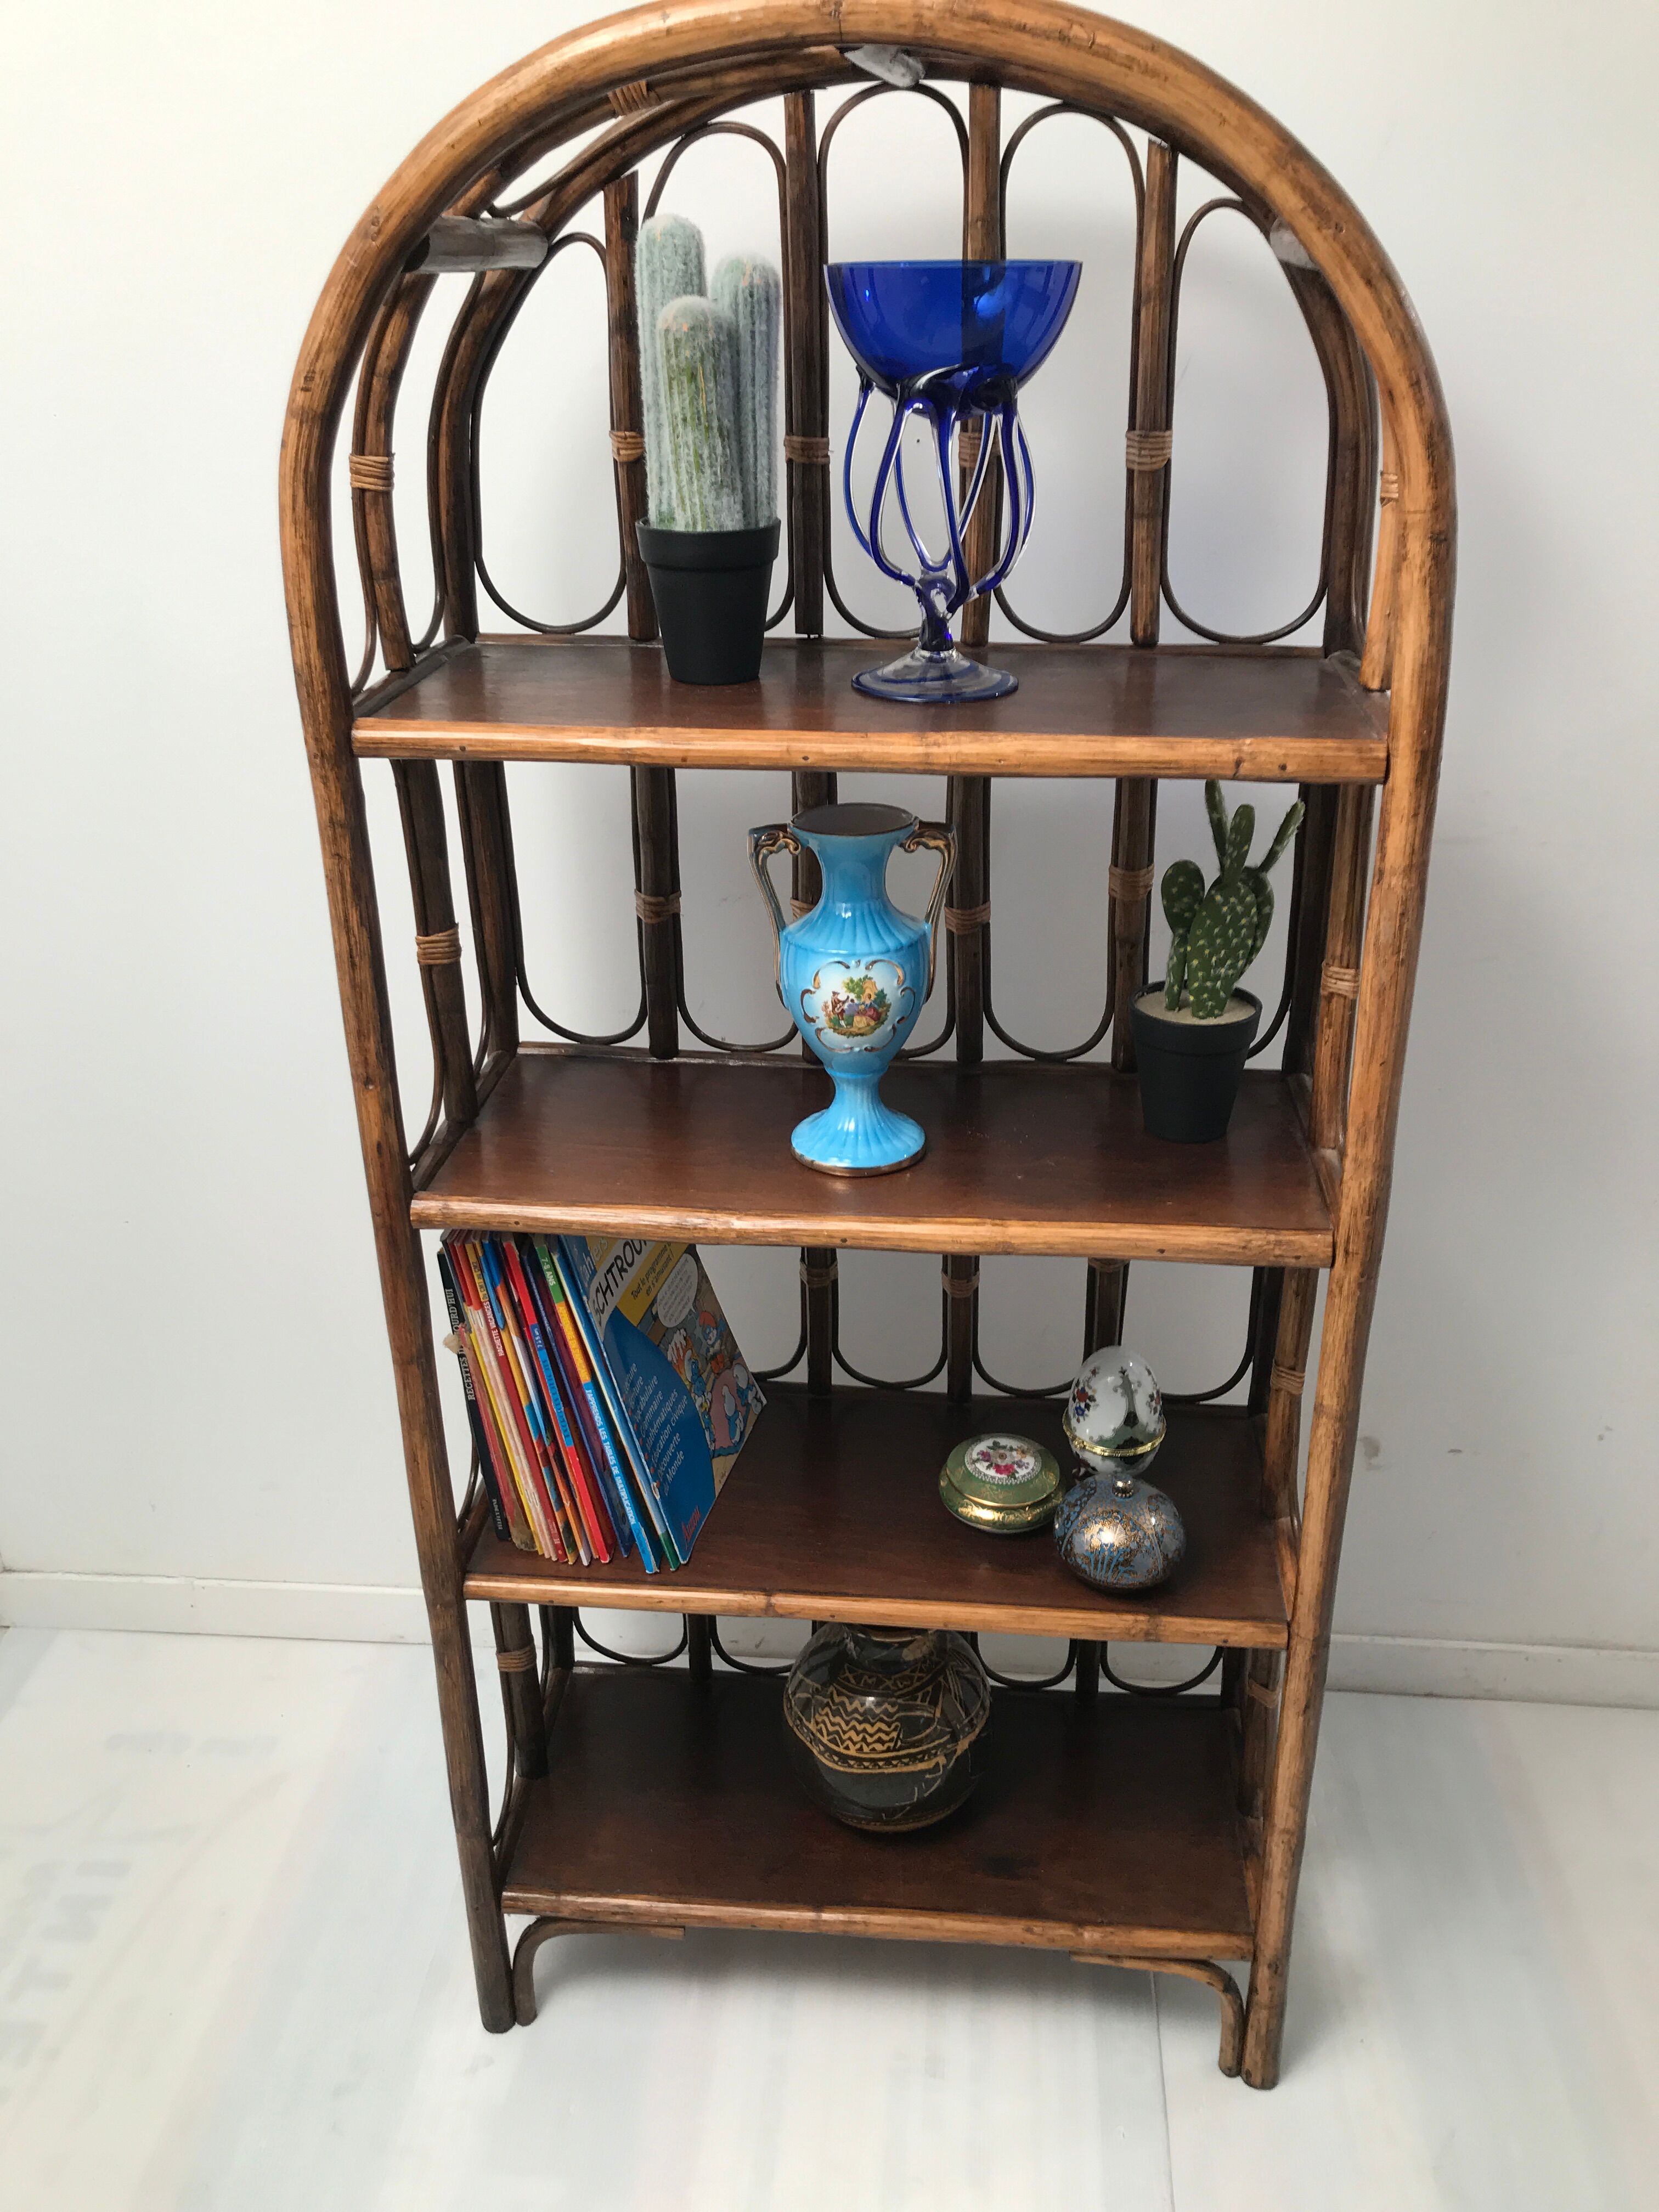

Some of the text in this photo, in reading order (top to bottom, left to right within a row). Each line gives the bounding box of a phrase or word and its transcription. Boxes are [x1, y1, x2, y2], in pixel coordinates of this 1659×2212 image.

[541, 1257, 556, 1286] 7-8 ANS
[631, 1282, 642, 1300] Tout
[645, 1244, 668, 1283] programme
[646, 1285, 652, 1296] en
[483, 1301, 496, 1329] VACANCES
[491, 1329, 505, 1357] HACHETTE
[461, 1356, 476, 1401] RECETTES
[670, 1395, 687, 1426] civique
[603, 1440, 616, 1465] TABLES
[611, 1465, 620, 1475] DE
[666, 1451, 684, 1484] Monde
[614, 1475, 636, 1525] MULTIPLICATION
